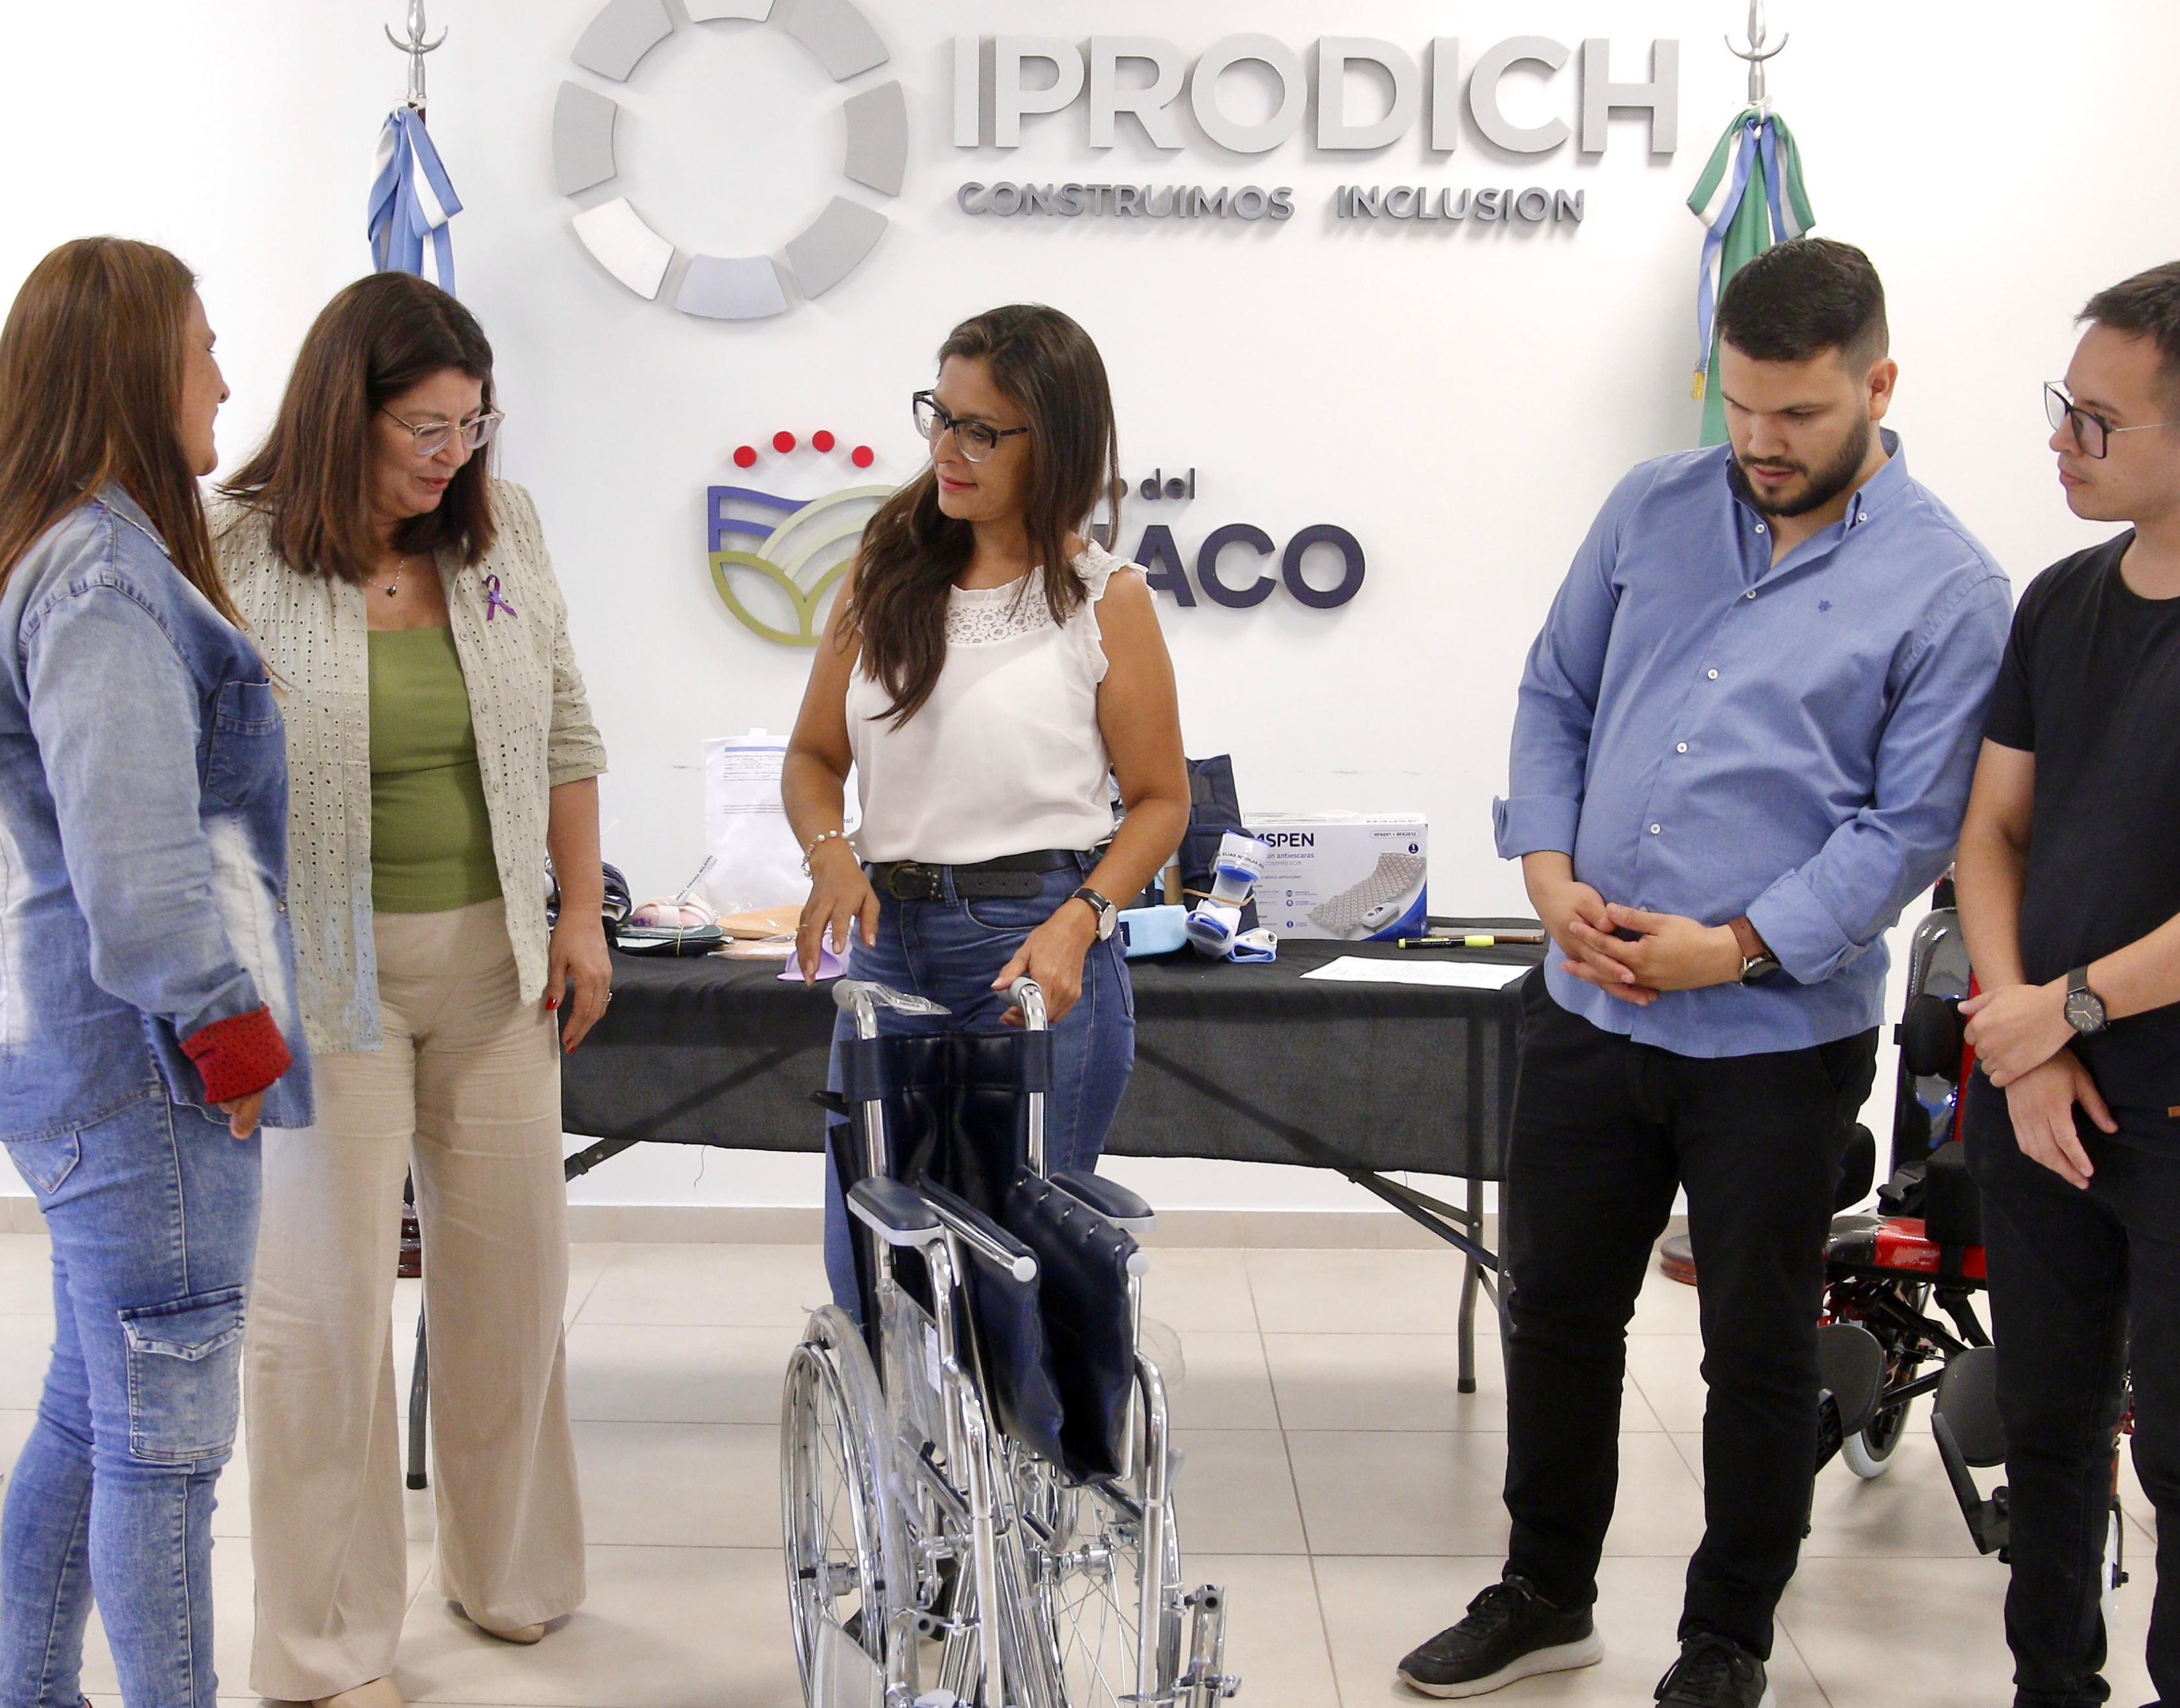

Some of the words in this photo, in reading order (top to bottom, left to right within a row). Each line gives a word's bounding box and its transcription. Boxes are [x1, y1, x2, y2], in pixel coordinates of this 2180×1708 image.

[952, 33, 1679, 156] IPRODICH
[955, 181, 1295, 222] CONSTRUIMOS
[1337, 184, 1585, 222] INCLUSION
[1140, 467, 1195, 501] del
[1091, 523, 1366, 609] ACO
